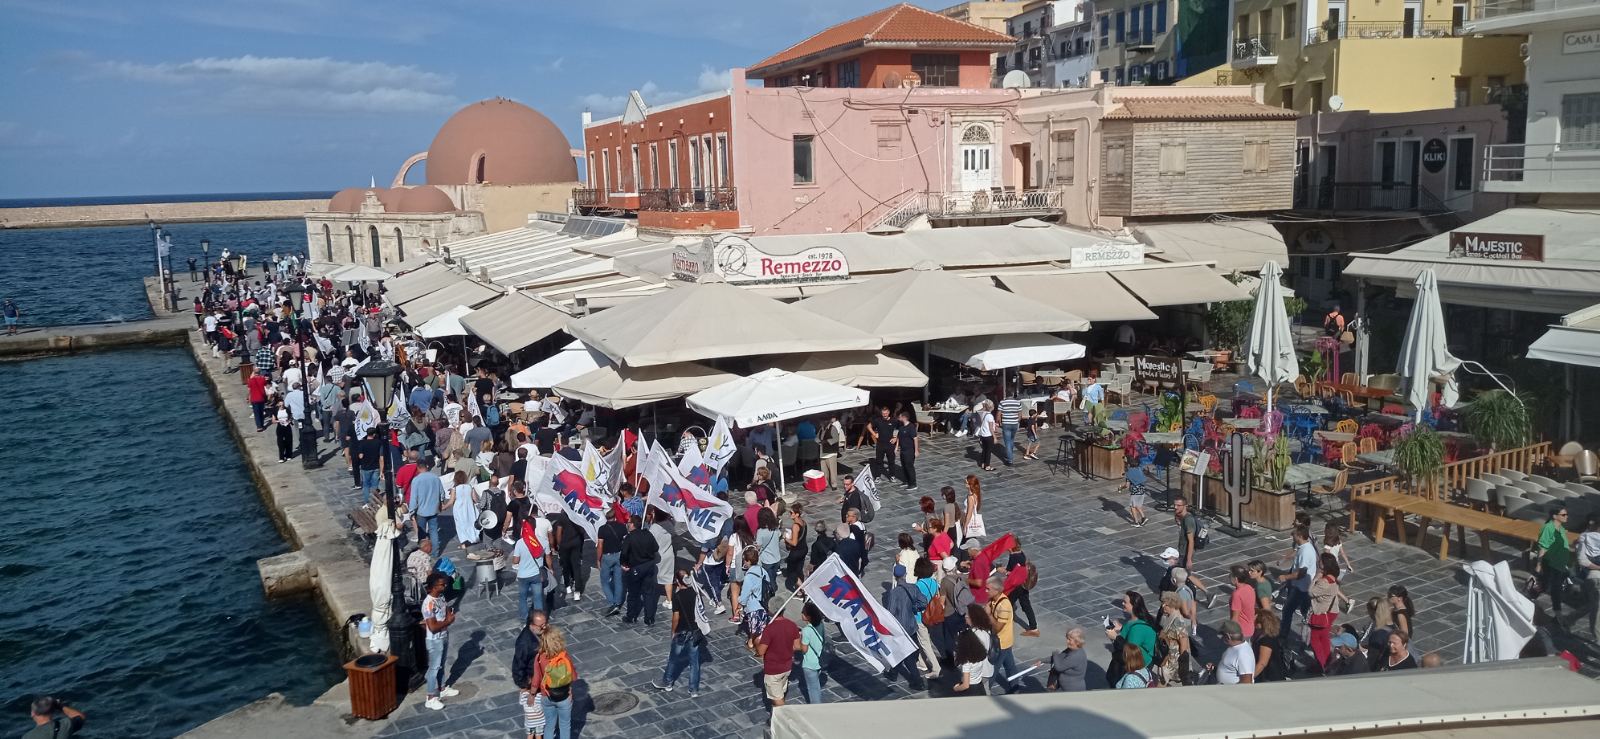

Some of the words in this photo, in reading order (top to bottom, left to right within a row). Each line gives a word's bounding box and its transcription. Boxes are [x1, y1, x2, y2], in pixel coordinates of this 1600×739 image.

[1465, 236, 1523, 253] MAJESTIC
[1085, 250, 1130, 261] REMEZZO
[760, 258, 842, 276] Remezzo
